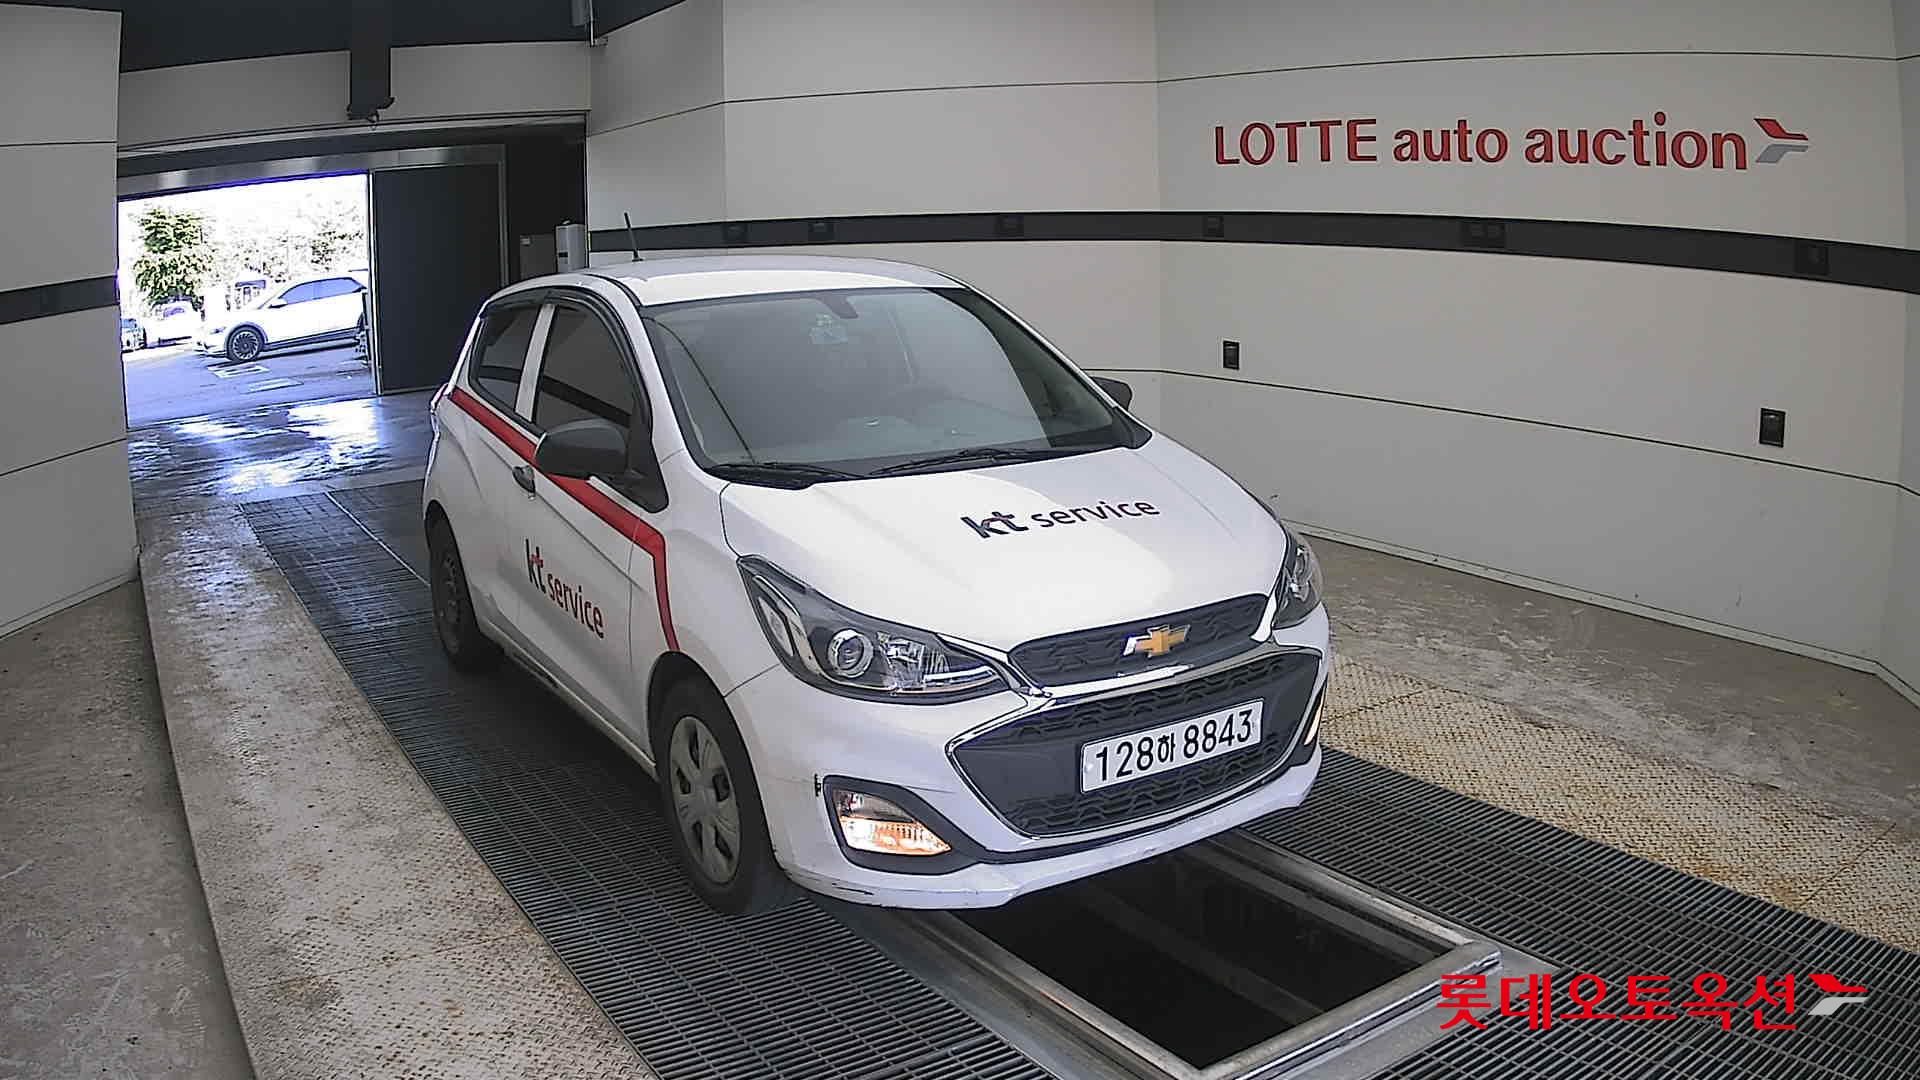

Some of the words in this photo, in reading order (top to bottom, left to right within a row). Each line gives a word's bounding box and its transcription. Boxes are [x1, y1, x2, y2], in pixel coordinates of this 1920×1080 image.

[1214, 118, 1378, 166] LOTTE
[1392, 118, 1509, 163] auto
[1524, 110, 1748, 171] auction
[960, 511, 1029, 539] kt
[1030, 500, 1161, 528] service
[525, 538, 547, 594] kt
[547, 573, 605, 639] service
[1095, 732, 1176, 782] 128하
[1183, 708, 1254, 760] 8843
